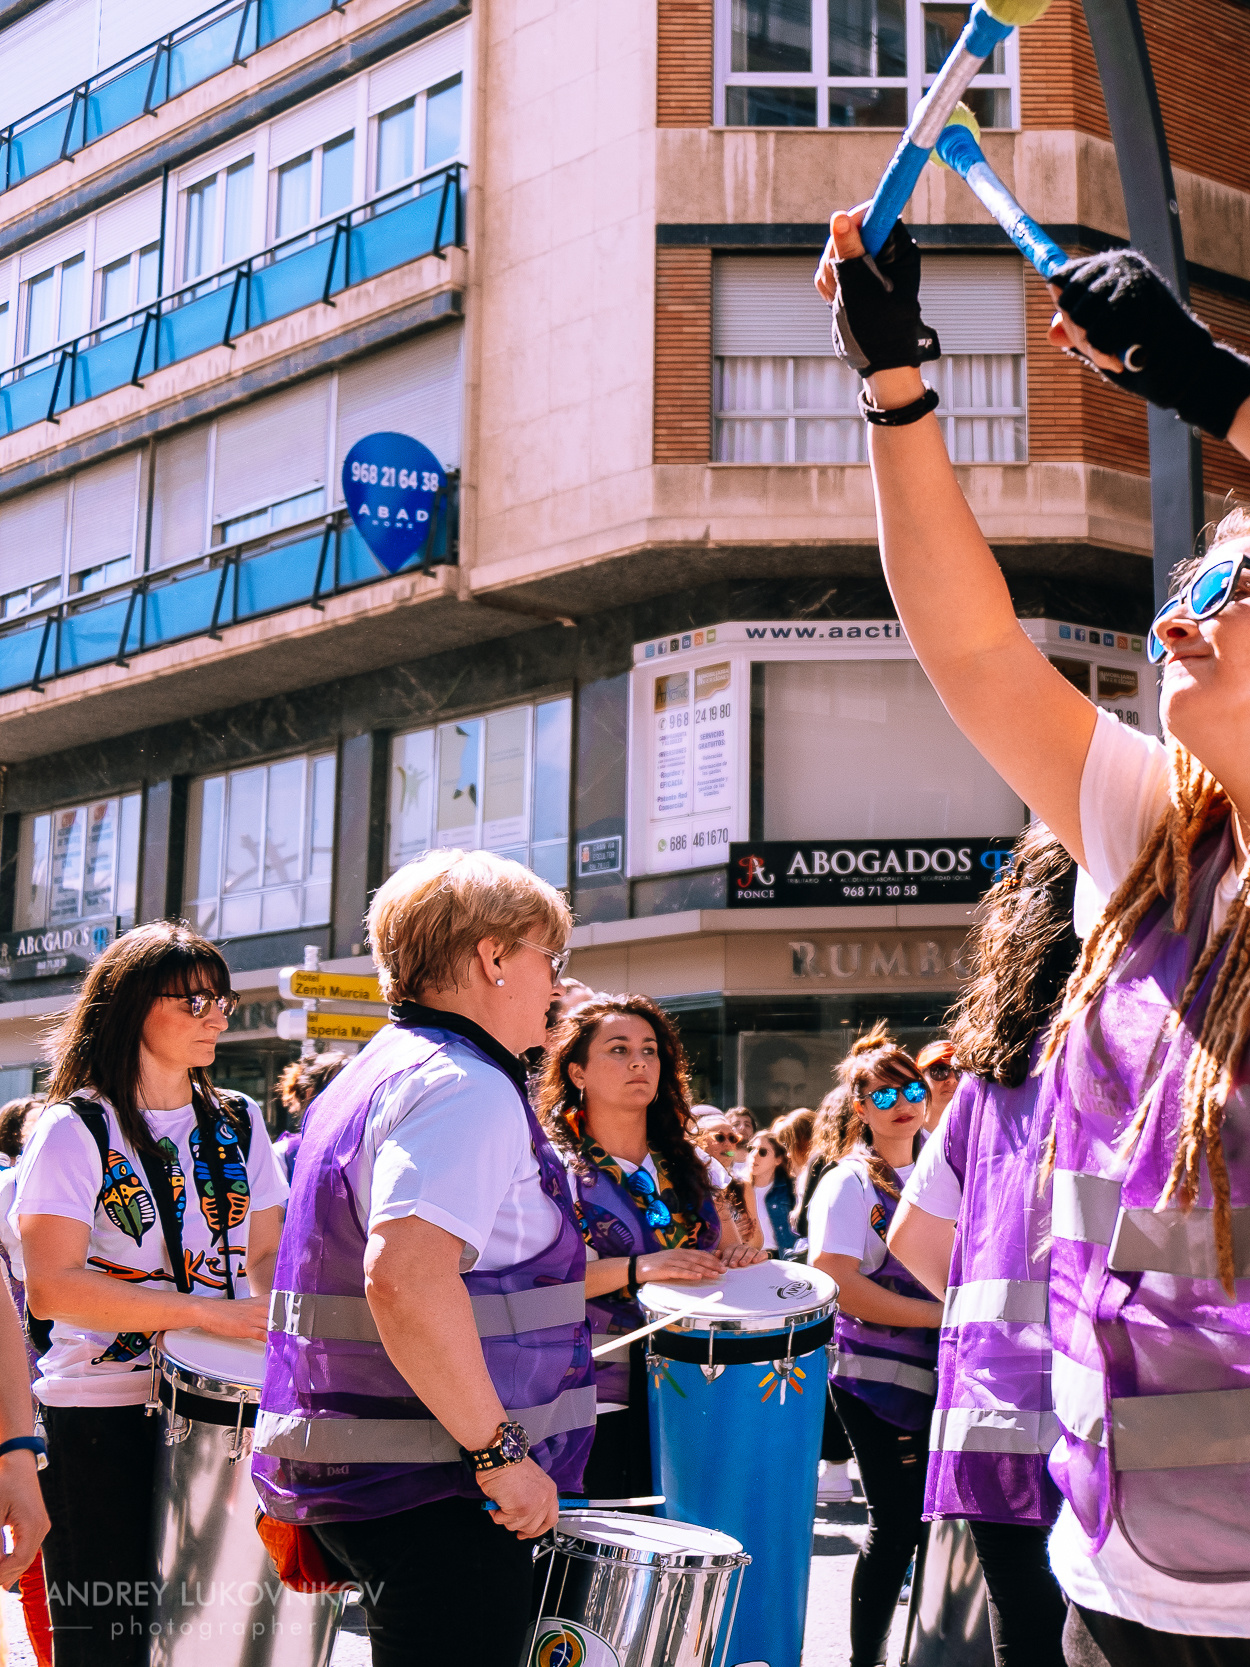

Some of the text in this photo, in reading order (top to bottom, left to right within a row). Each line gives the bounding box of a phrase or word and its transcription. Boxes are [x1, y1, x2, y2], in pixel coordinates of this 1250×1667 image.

[351, 461, 439, 492] 968 21 64 38
[358, 503, 429, 522] ABAD
[669, 703, 731, 729] 968 24 19 80
[1126, 711, 1139, 725] 80
[669, 834, 687, 852] 686
[786, 848, 972, 875] ABOGADOS
[737, 889, 775, 899] PONCE
[843, 885, 918, 897] 968 71 30 58
[17, 926, 91, 956] ABOGADOS
[296, 973, 320, 982] hotel
[295, 983, 370, 999] Zenit Murcia
